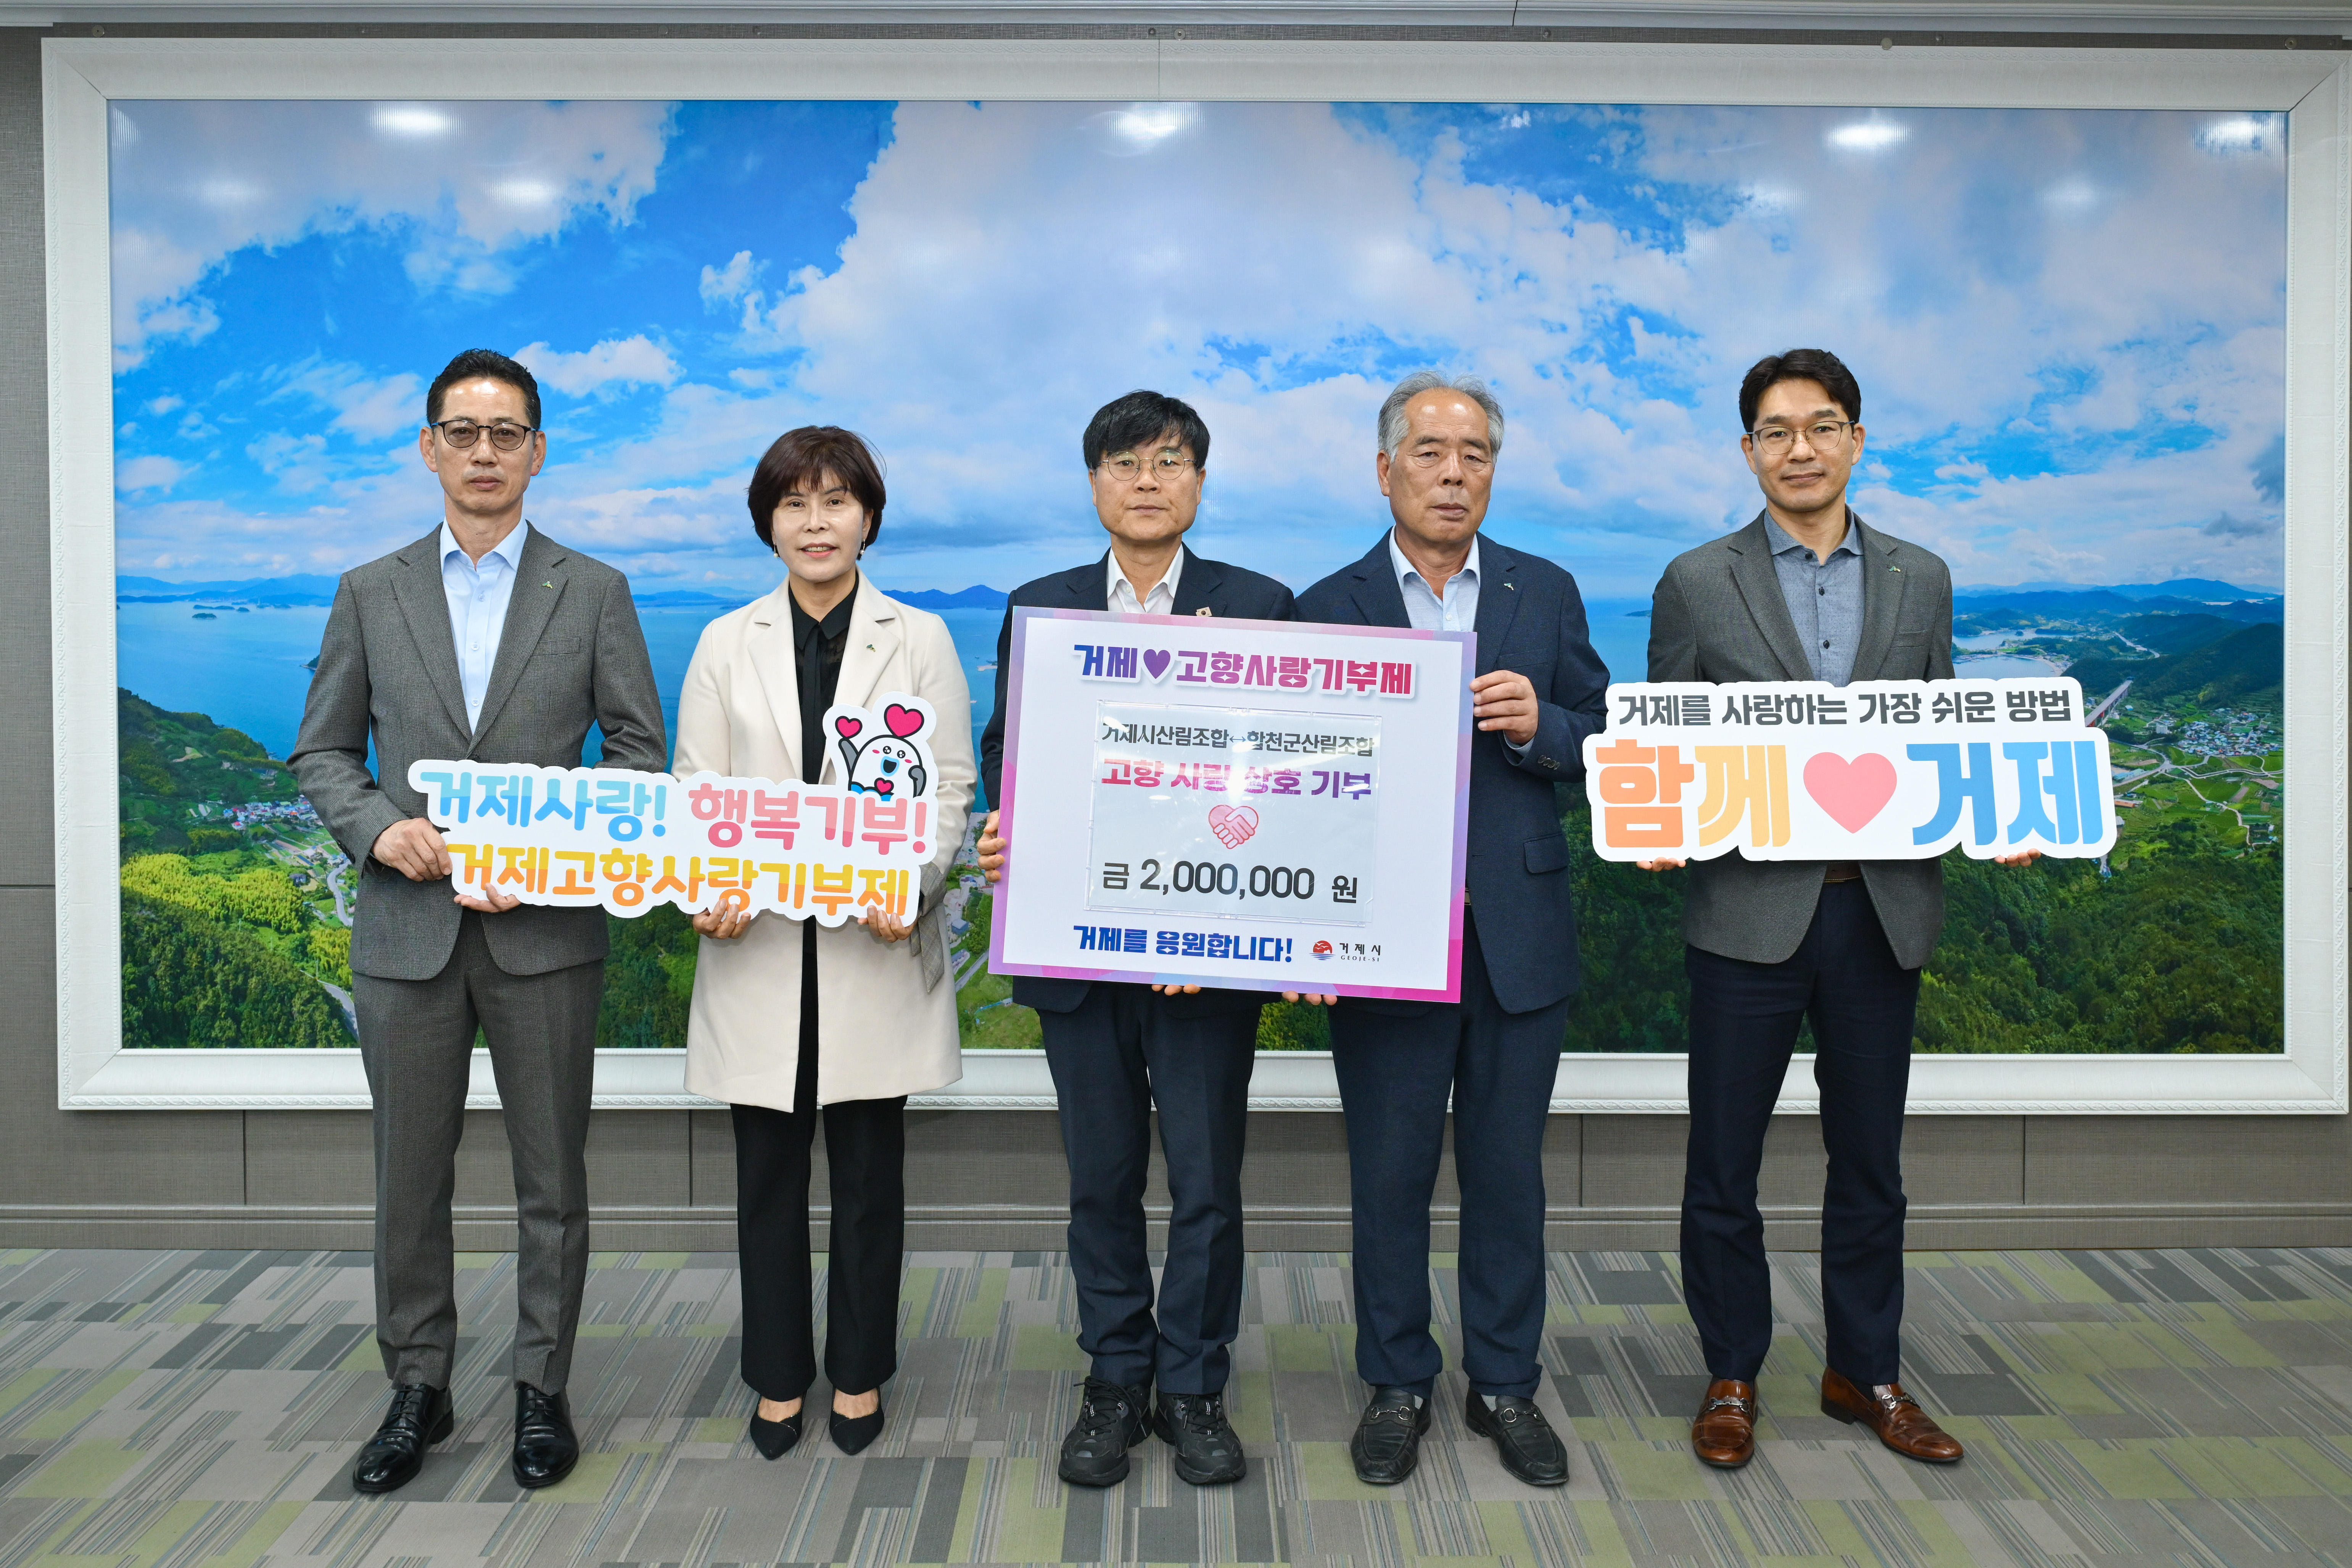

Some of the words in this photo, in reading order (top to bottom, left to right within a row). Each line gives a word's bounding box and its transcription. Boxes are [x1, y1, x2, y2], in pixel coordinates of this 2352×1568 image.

[1074, 644, 1138, 679] 거제
[1177, 649, 1413, 695] 고향사랑기부제
[1618, 694, 1711, 726] 거제를
[1721, 694, 1847, 725] 사랑하는
[1858, 692, 1921, 724] 가장
[1932, 691, 1996, 724] 쉬운
[2006, 689, 2072, 722] 방법
[1102, 722, 1229, 749] 거제시산림조합
[1248, 730, 1375, 757] 합천군산림조합
[1101, 758, 1164, 787] 고향
[1311, 770, 1371, 800] 기부
[1595, 739, 1791, 848] 함께
[1906, 741, 2104, 846] 거제
[420, 771, 666, 842] 거제사랑!
[689, 782, 927, 855] 행복기부!
[447, 843, 909, 917] 거제고향사랑기부제
[1103, 862, 1130, 890] 금
[1140, 858, 1315, 900] 2,000,000
[1331, 874, 1358, 904] 원
[1073, 925, 1148, 953] 거제를
[1156, 930, 1293, 963] 응원합니다!
